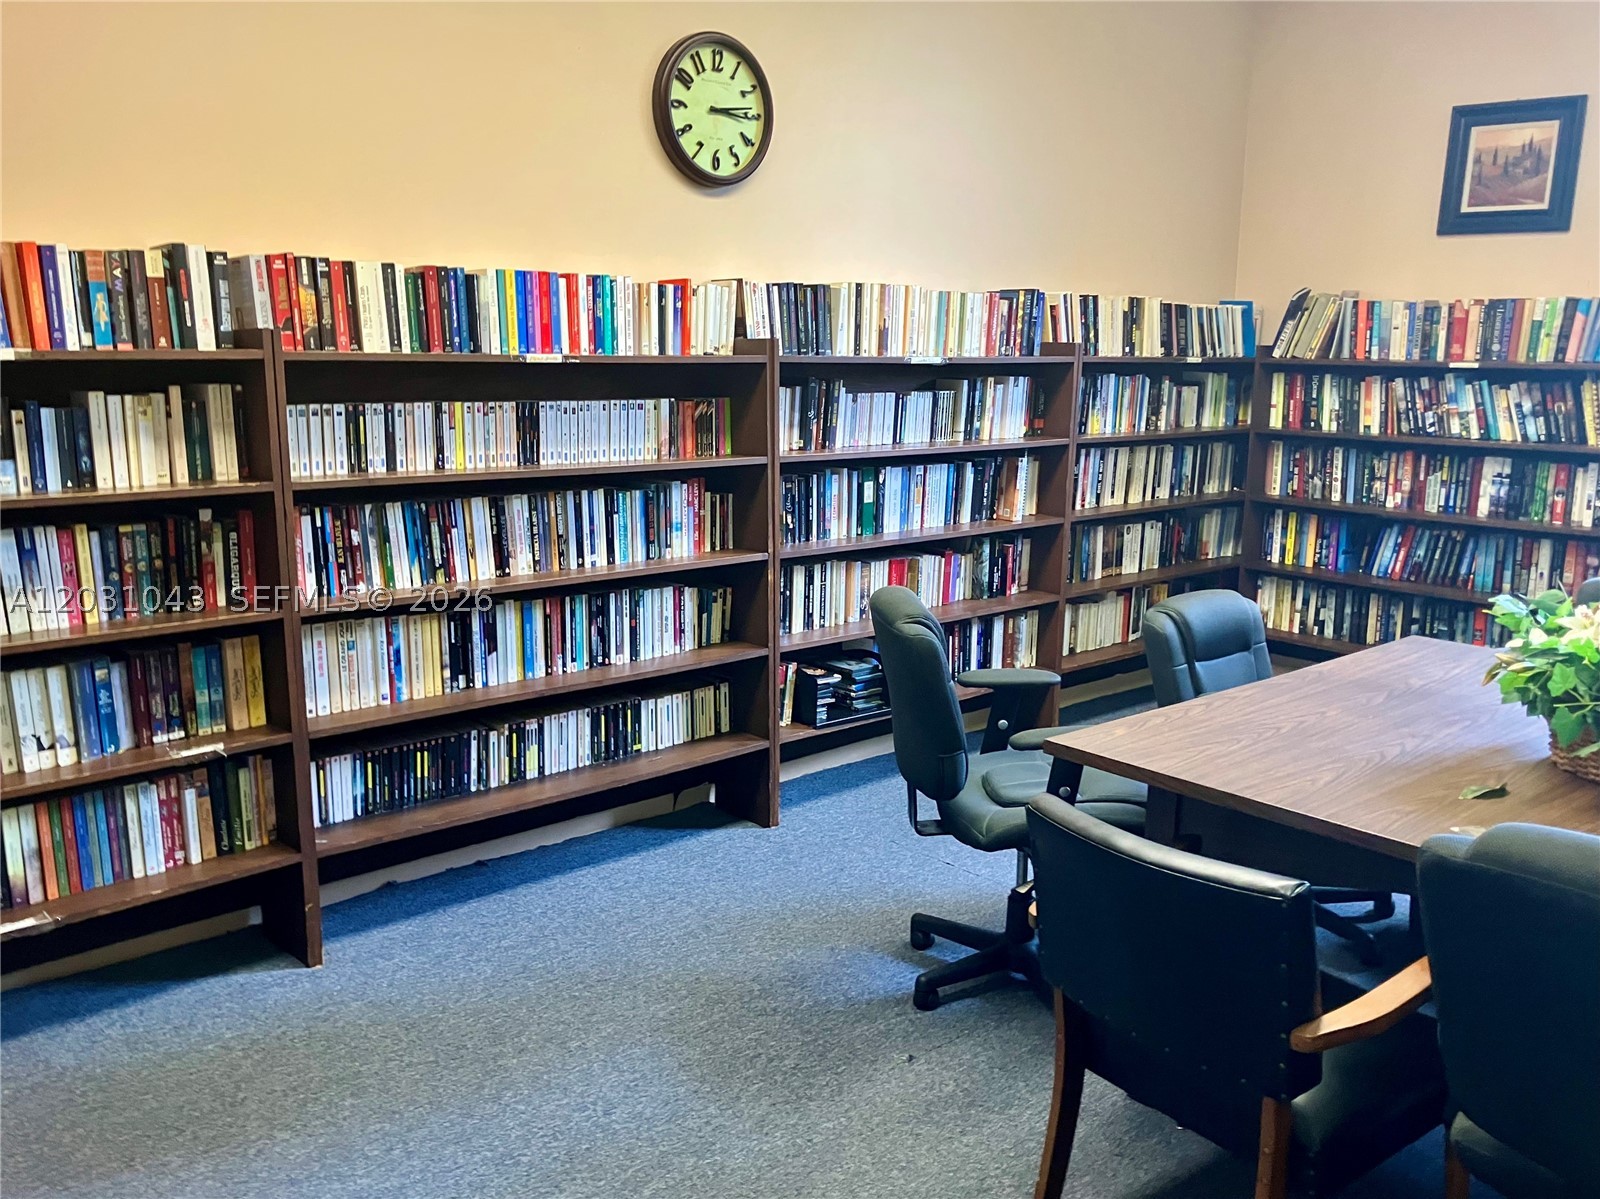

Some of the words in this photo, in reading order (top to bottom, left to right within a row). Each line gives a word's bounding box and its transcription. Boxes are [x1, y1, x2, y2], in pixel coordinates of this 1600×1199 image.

[690, 51, 707, 75] 11
[712, 49, 724, 72] 12
[730, 61, 741, 80] 1
[675, 68, 694, 91] 10
[741, 84, 757, 98] 2
[671, 99, 688, 109] 9
[744, 112, 761, 121] 3
[676, 124, 692, 136] 8
[739, 132, 755, 147] 4
[692, 141, 704, 160] 7
[712, 149, 720, 170] 6
[729, 145, 740, 167] 5
[531, 510, 539, 534] HEARST
[533, 535, 541, 560] PATRICIA
